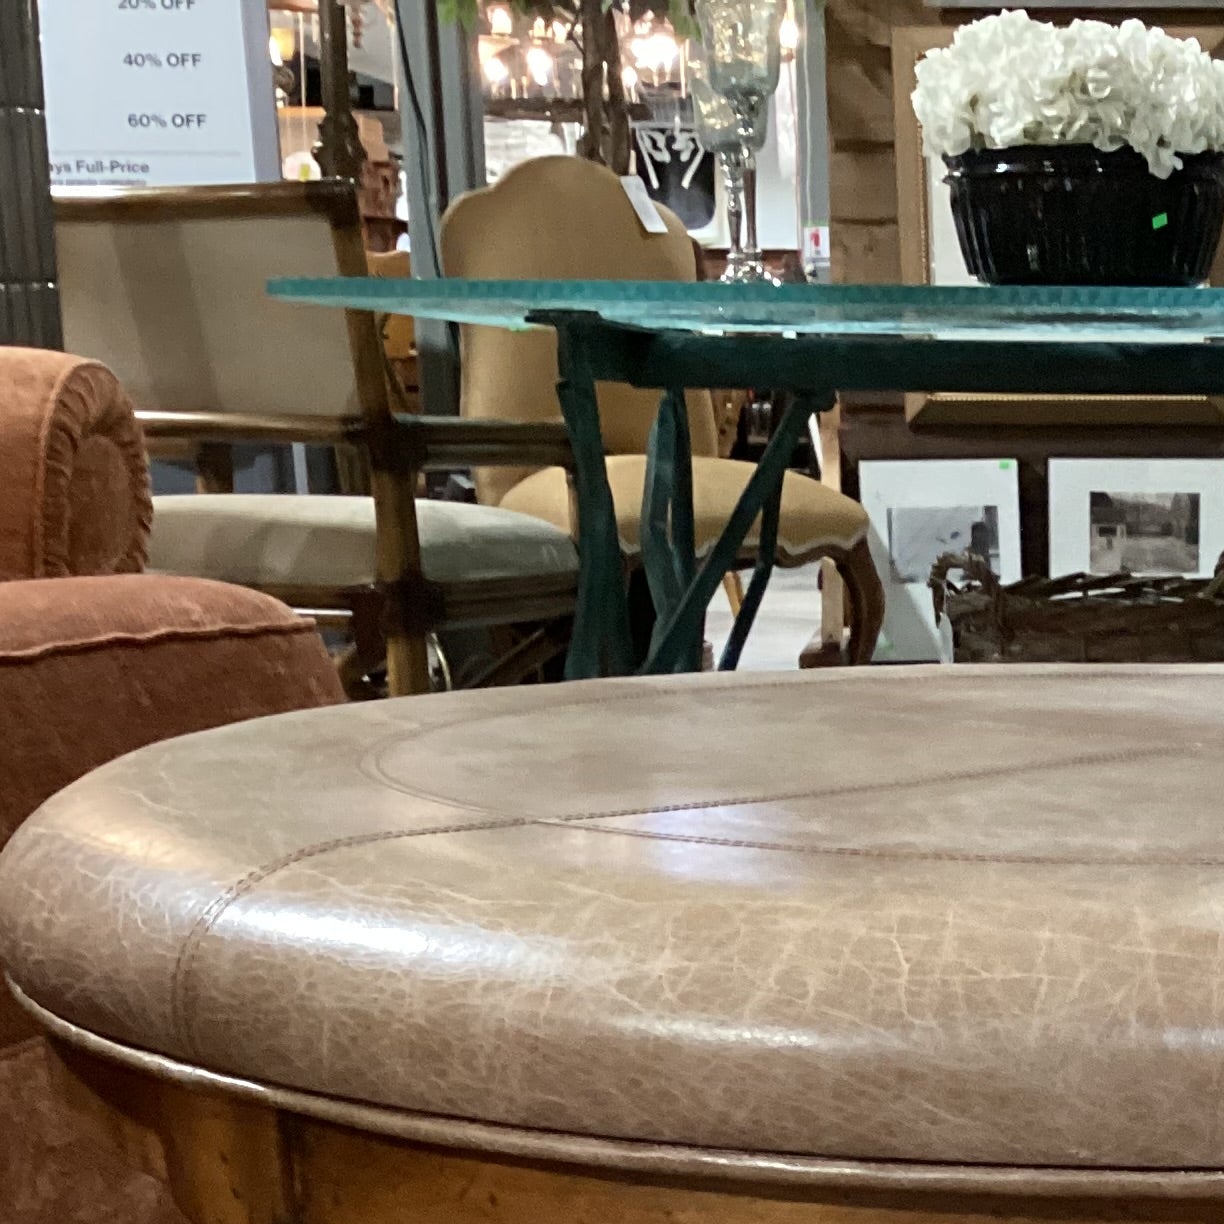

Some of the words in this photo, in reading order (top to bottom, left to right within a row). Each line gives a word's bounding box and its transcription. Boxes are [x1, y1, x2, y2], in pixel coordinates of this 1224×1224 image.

[161, 0, 196, 10] OFF
[123, 53, 162, 67] 40%
[166, 53, 202, 67] OFF
[127, 113, 168, 127] 60%
[171, 113, 207, 127] OFF
[49, 162, 72, 175] ays
[75, 159, 150, 174] Full-Price
